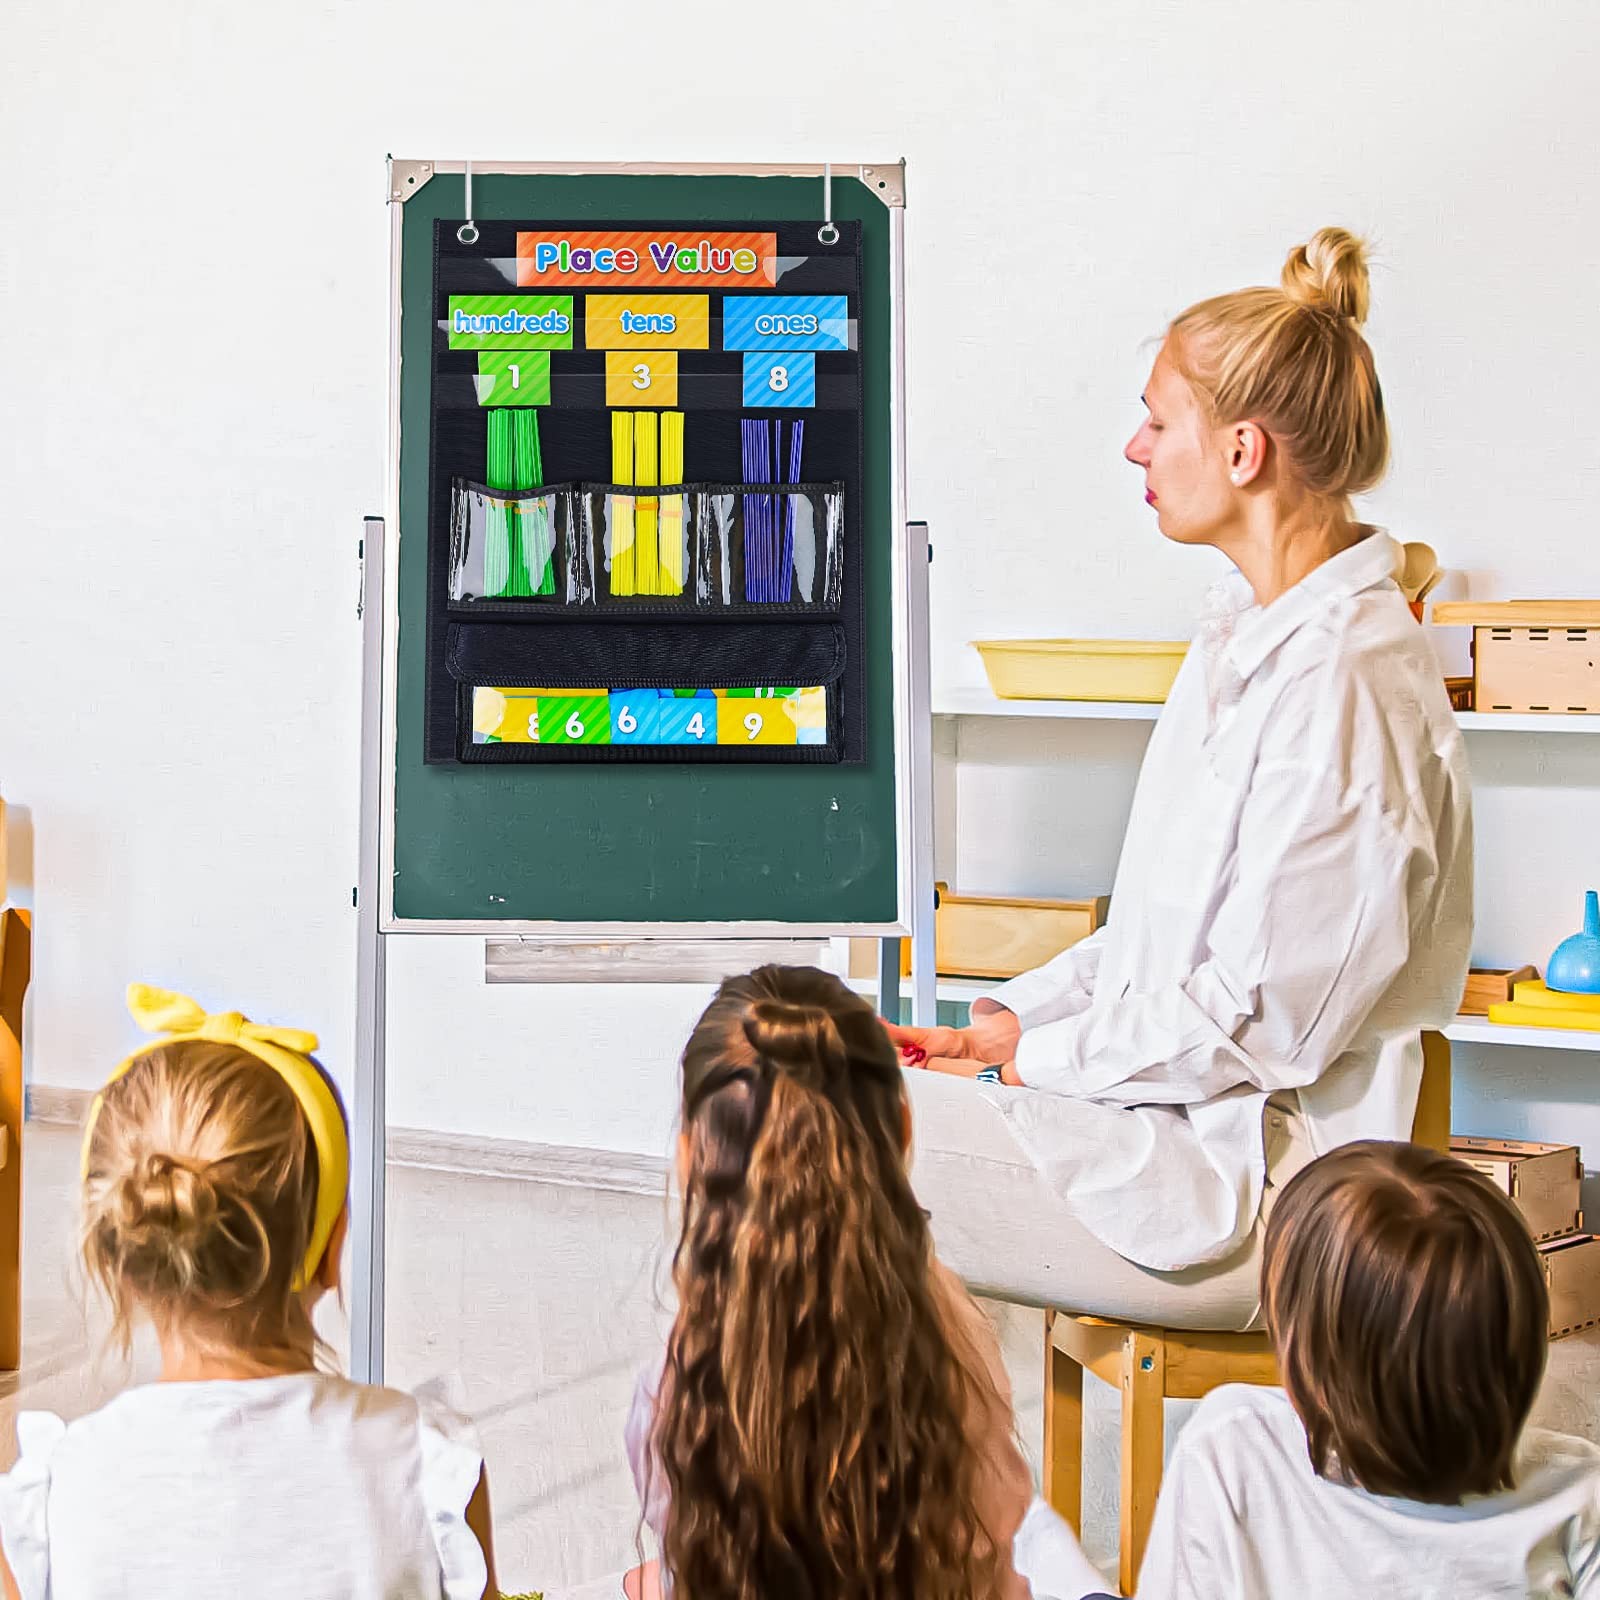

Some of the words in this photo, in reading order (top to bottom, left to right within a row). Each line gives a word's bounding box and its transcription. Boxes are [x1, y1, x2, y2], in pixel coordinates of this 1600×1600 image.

[535, 241, 638, 274] Place
[649, 240, 757, 274] Value
[454, 309, 570, 334] hundreds
[621, 310, 676, 334] tens
[754, 314, 818, 334] ones
[507, 364, 520, 389] 1
[632, 364, 652, 390] 3
[768, 366, 789, 392] 8
[565, 711, 585, 739] 6
[617, 706, 638, 734] 6
[685, 712, 706, 739] 4
[743, 712, 763, 740] 9
